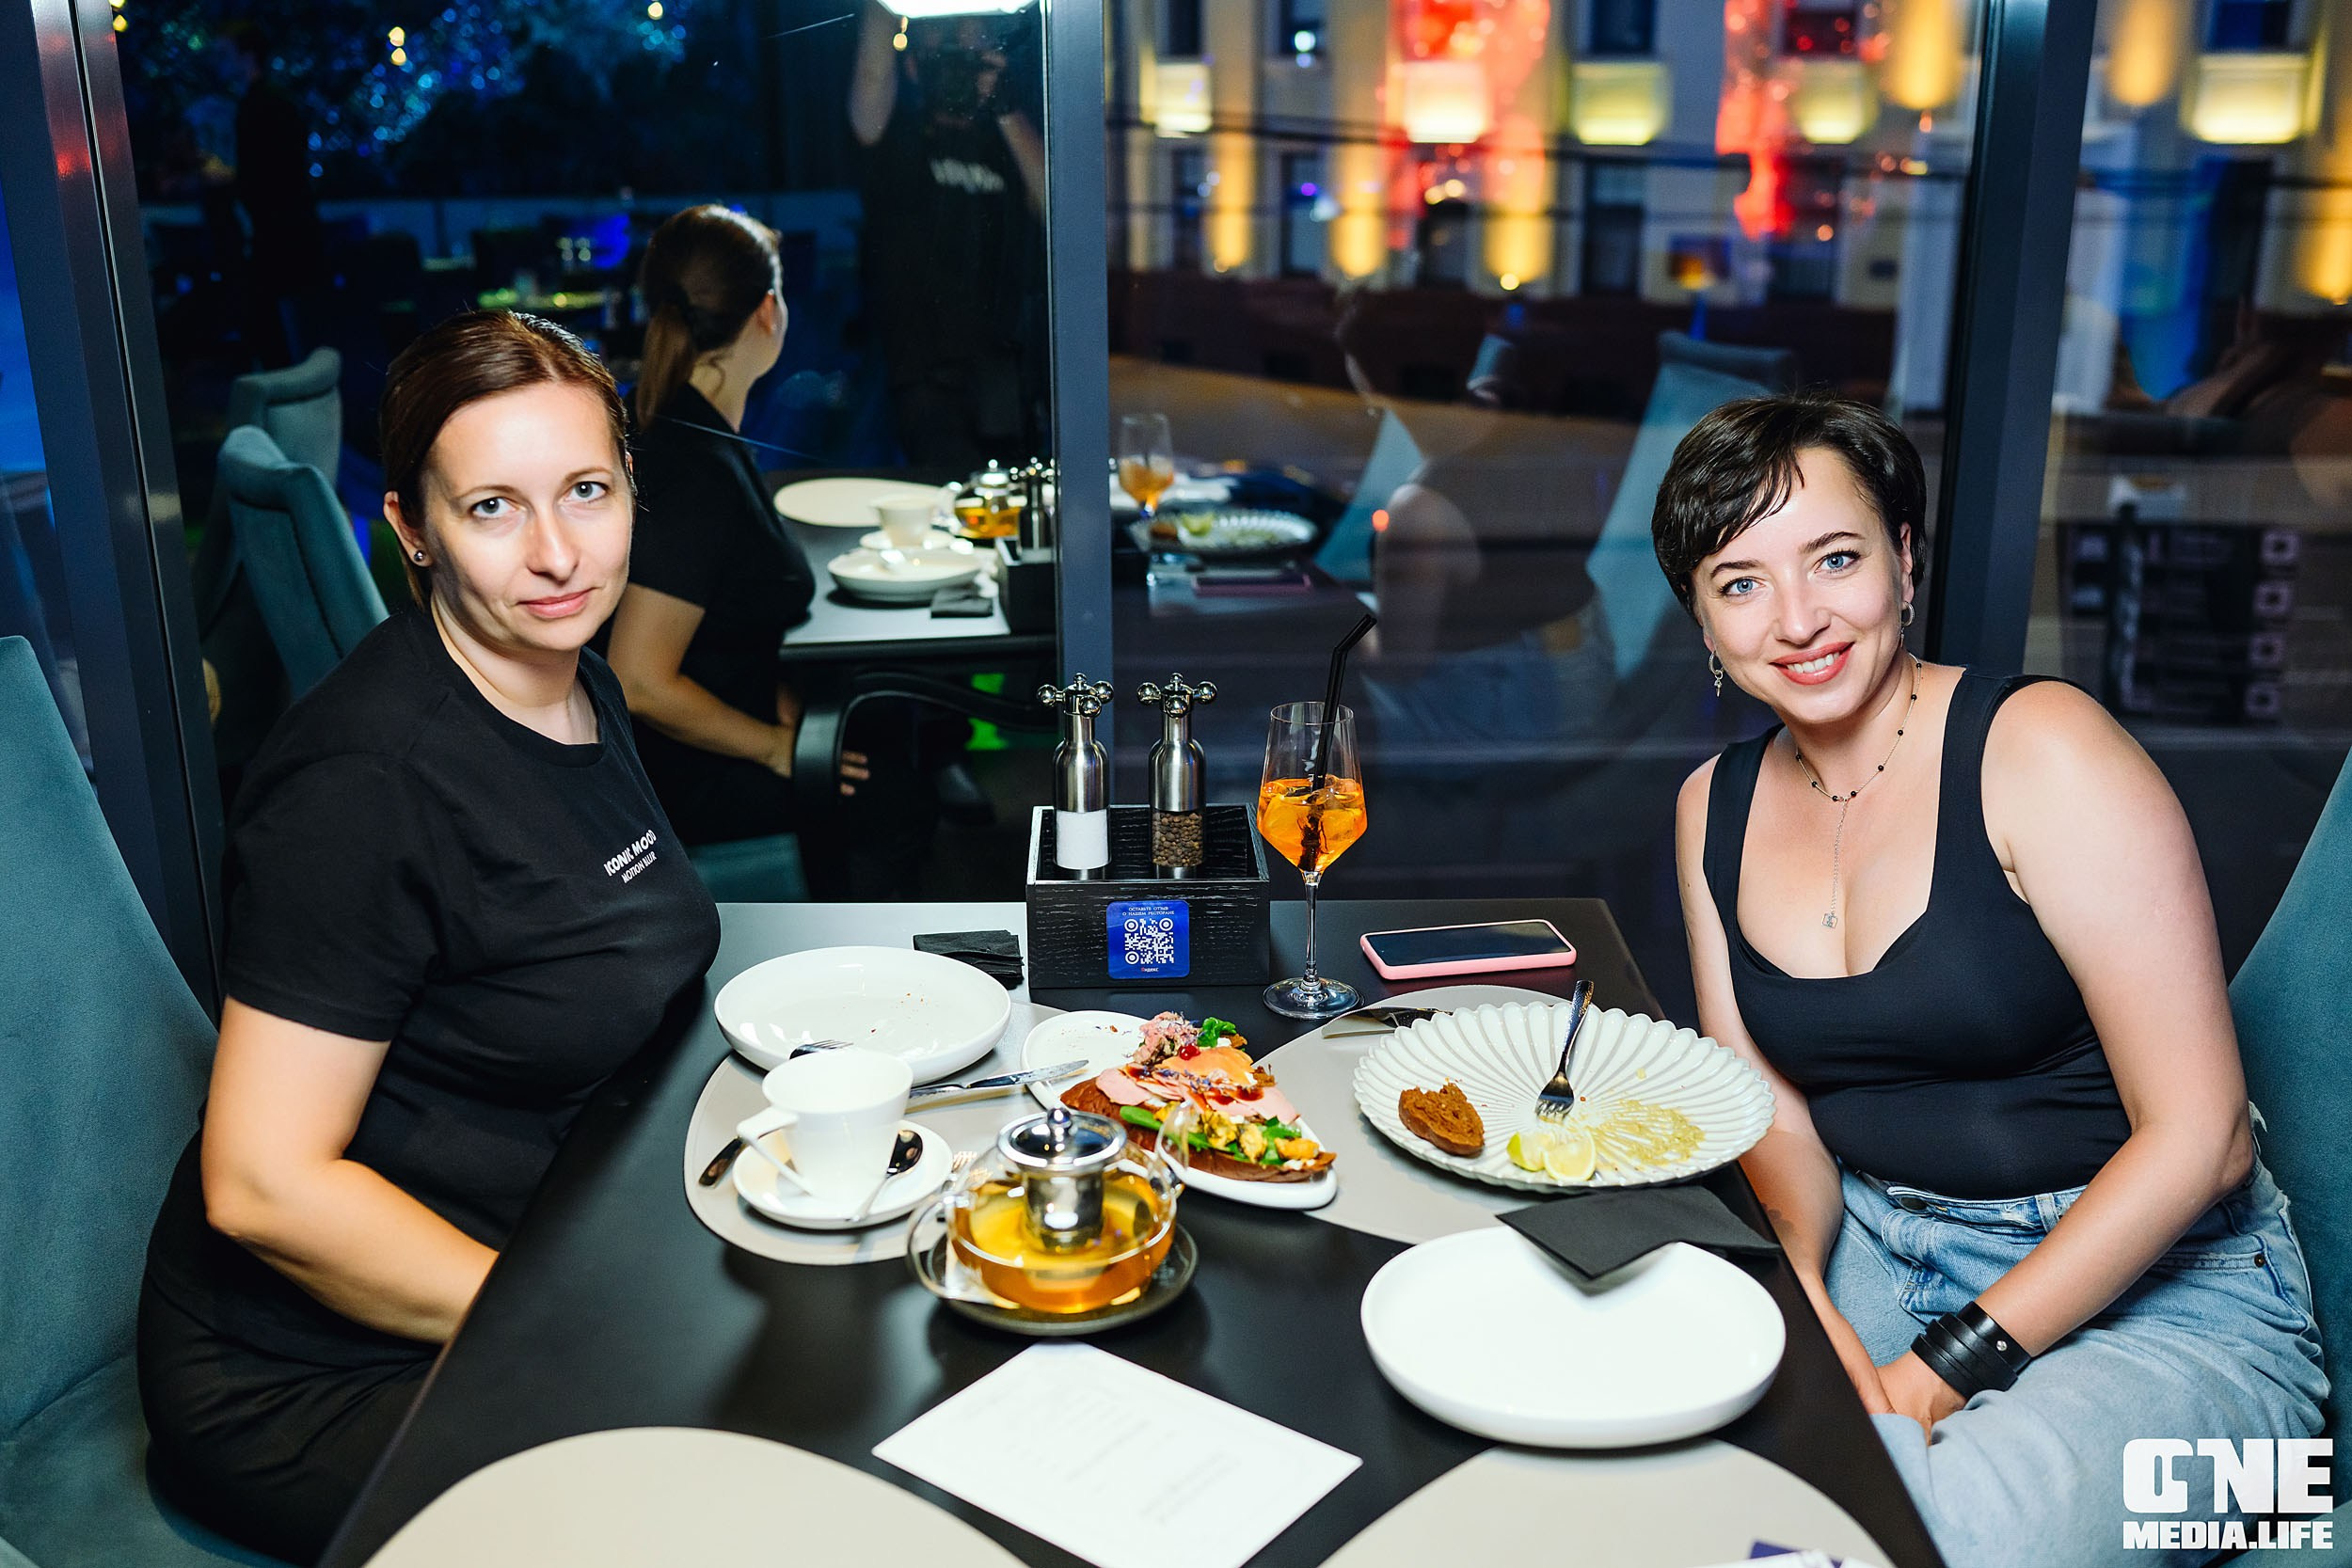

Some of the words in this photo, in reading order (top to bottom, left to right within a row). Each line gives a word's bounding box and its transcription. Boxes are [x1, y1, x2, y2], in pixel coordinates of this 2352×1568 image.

[604, 847, 634, 877] ICONIC
[631, 829, 657, 857] MOOD
[621, 860, 645, 884] MOTION
[642, 850, 658, 867] BLUR
